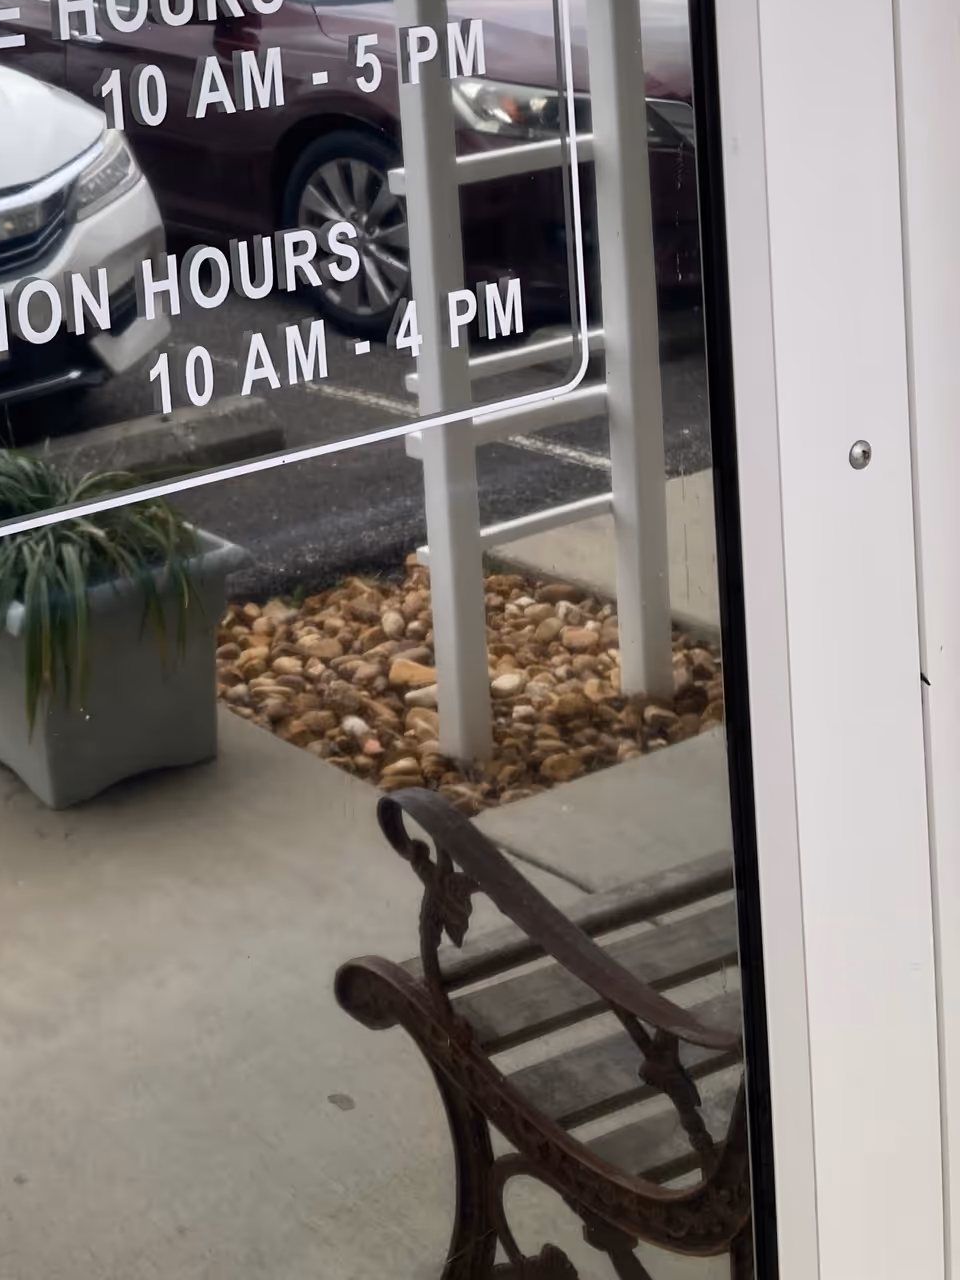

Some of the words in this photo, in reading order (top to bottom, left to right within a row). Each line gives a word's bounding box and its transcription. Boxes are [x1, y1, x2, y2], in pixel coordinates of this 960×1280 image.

[100, 64, 168, 131] 10
[195, 47, 285, 118] AM
[313, 71, 328, 85] -
[356, 34, 382, 93] 5
[407, 19, 486, 84] PM
[143, 221, 360, 320] HOURS
[150, 345, 213, 414] 10
[242, 320, 328, 396] AM
[355, 340, 370, 355] -
[396, 300, 422, 357] 4
[449, 278, 524, 348] PM
